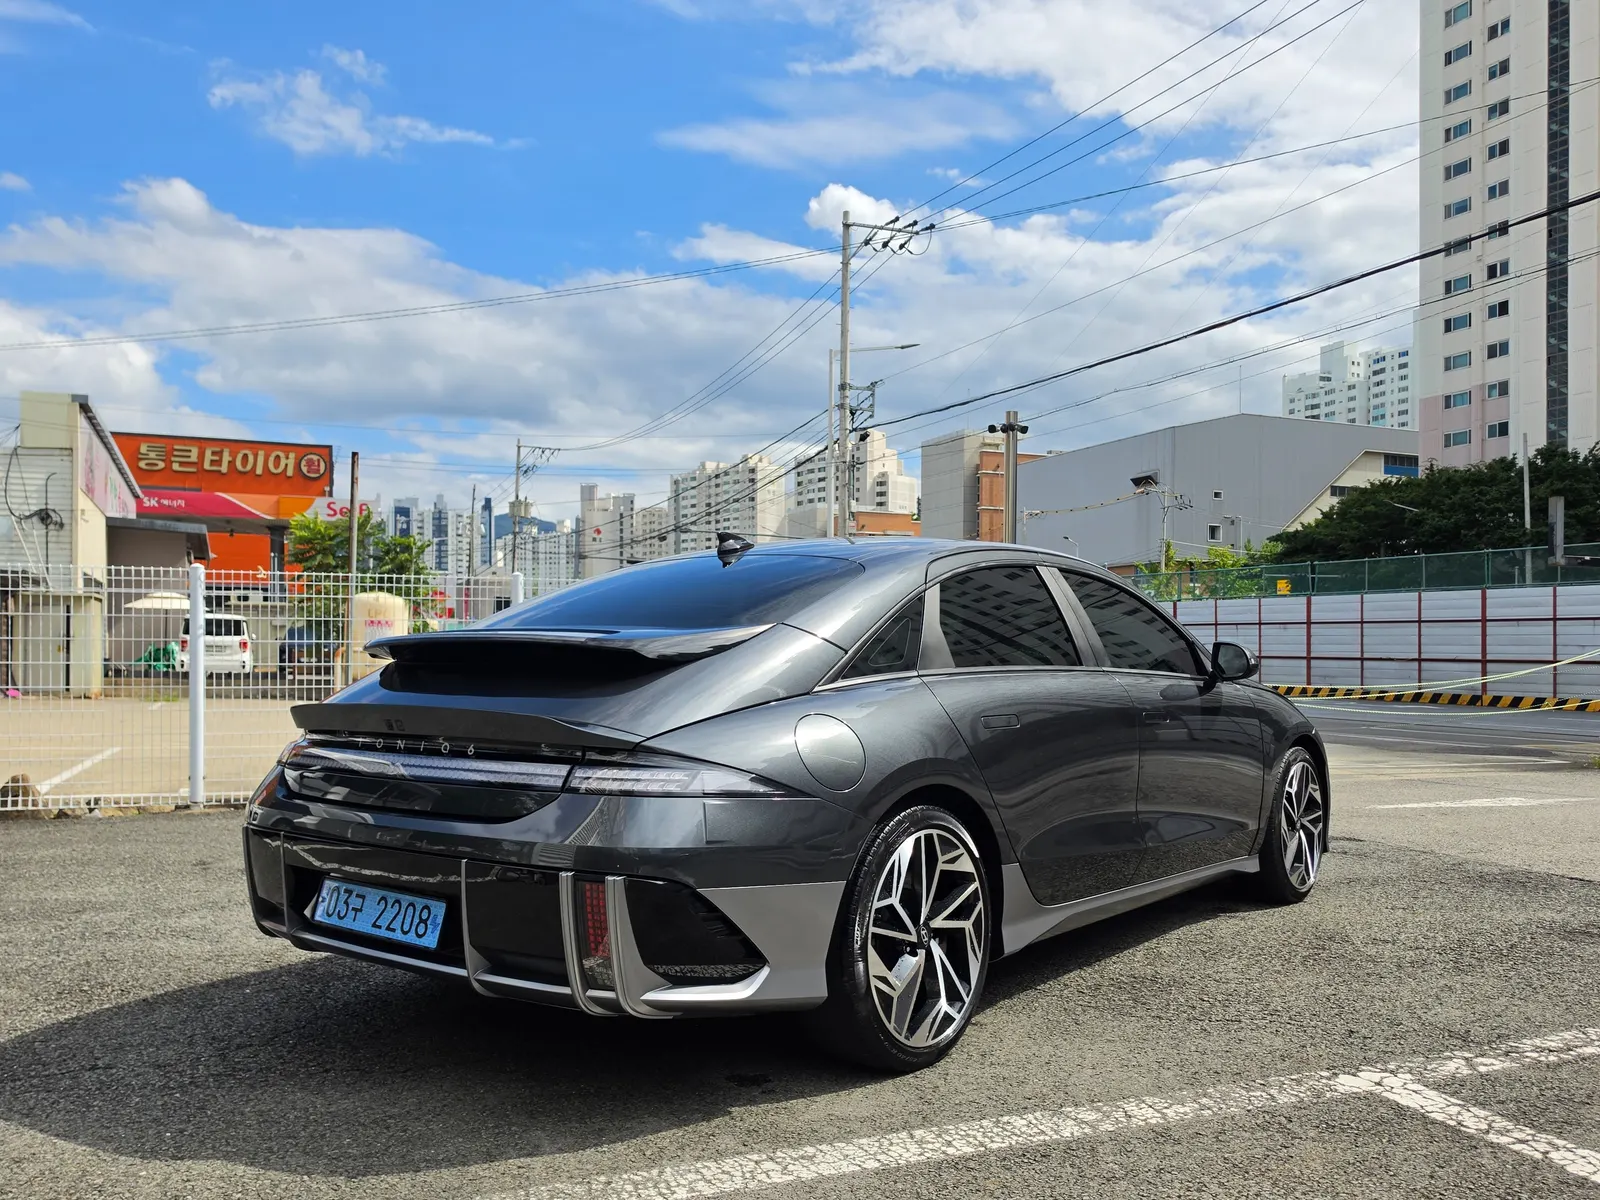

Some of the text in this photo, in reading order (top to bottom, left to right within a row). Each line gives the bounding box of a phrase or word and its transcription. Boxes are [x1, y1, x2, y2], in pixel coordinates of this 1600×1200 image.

[138, 442, 296, 477] 통큰타이어
[143, 497, 159, 507] SK
[326, 501, 368, 517] Sef
[358, 738, 475, 755] IONIQ 6
[325, 885, 432, 938] 03구 2208
